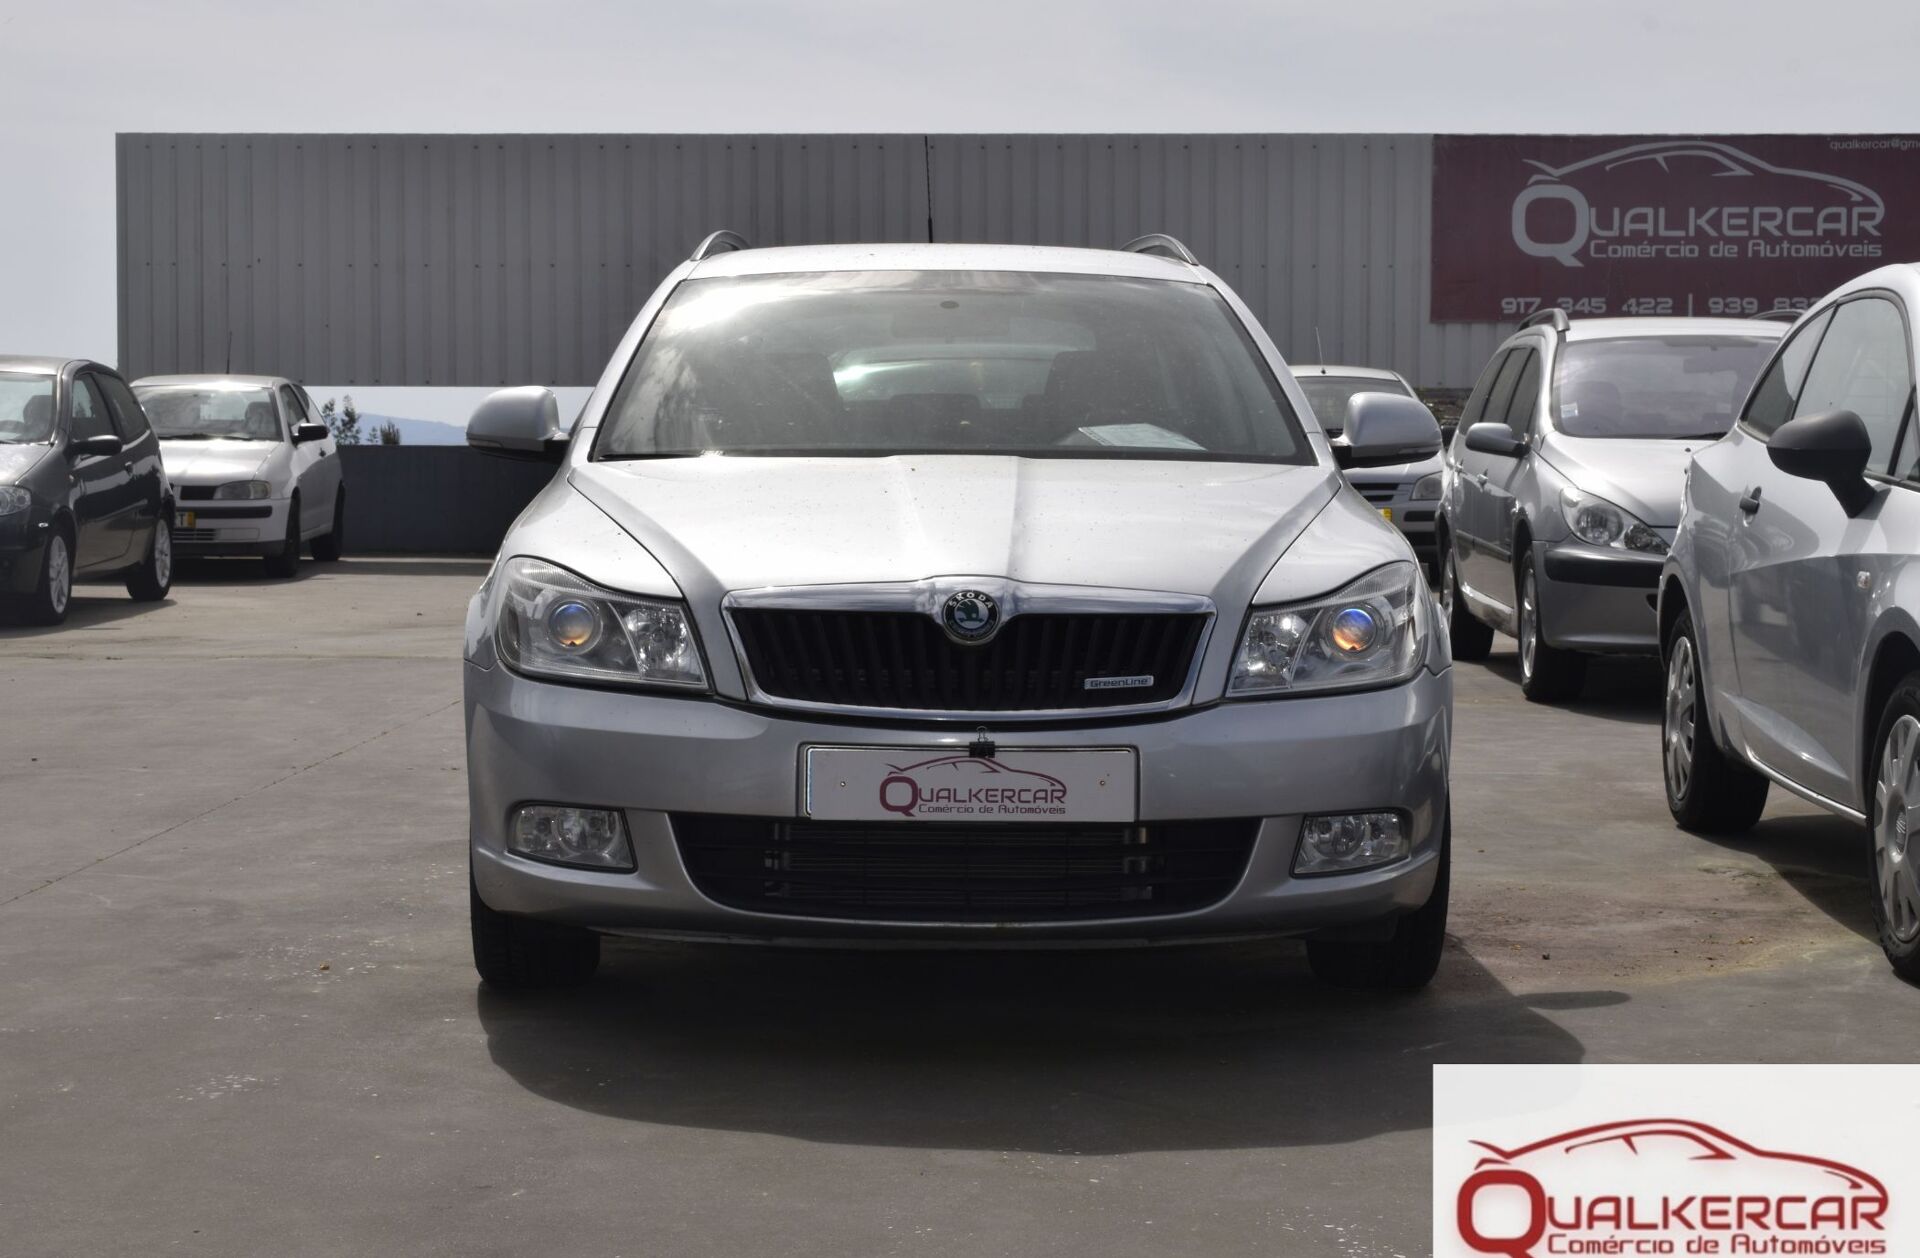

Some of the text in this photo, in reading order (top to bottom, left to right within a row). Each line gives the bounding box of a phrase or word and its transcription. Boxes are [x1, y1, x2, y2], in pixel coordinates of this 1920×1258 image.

[1512, 184, 1884, 267] QUALKERCAR
[1590, 239, 1883, 258] Comércio de Automóveis
[1501, 297, 1541, 314] 917
[1557, 297, 1607, 314] 345
[1622, 297, 1673, 314] 422
[1708, 297, 1758, 314] 939
[1774, 297, 1822, 311] 83
[880, 775, 1067, 817] QUALKERCAR
[919, 803, 1066, 815] Comércio de Automóveis
